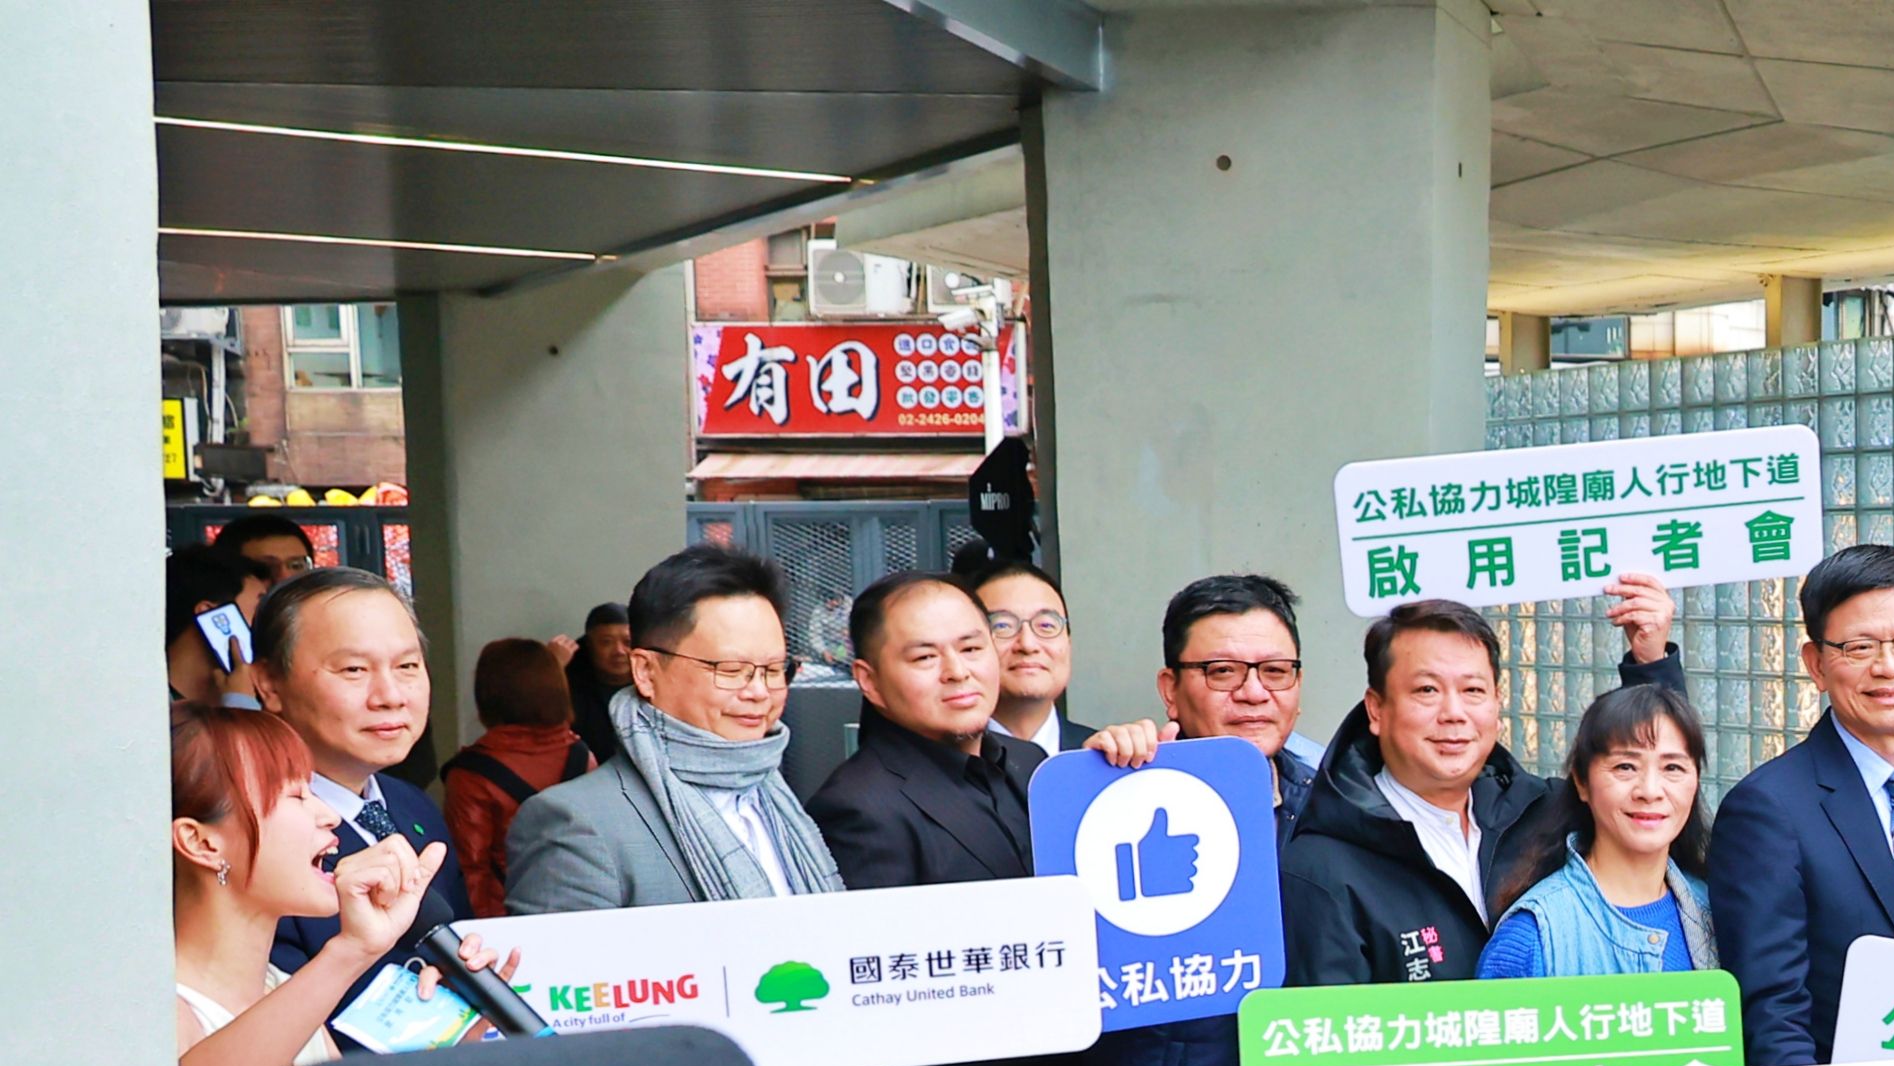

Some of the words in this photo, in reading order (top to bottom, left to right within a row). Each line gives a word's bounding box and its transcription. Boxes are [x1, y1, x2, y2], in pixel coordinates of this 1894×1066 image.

[721, 332, 880, 426] 有田
[1353, 453, 1801, 525] 公私協力城隍廟人行地下道
[1367, 509, 1795, 599] 啟用記者會
[849, 941, 1066, 985] 國泰世華銀行
[1420, 926, 1444, 963] 秘書
[549, 974, 699, 1012] KEELUNG
[851, 992, 902, 1007] Cathay
[906, 986, 955, 1003] United
[959, 982, 995, 998] Bank
[563, 1017, 586, 1028] city
[588, 1014, 610, 1024] full
[612, 1012, 626, 1022] of
[1262, 998, 1727, 1057] 公私協力城隍廟人行地下道
